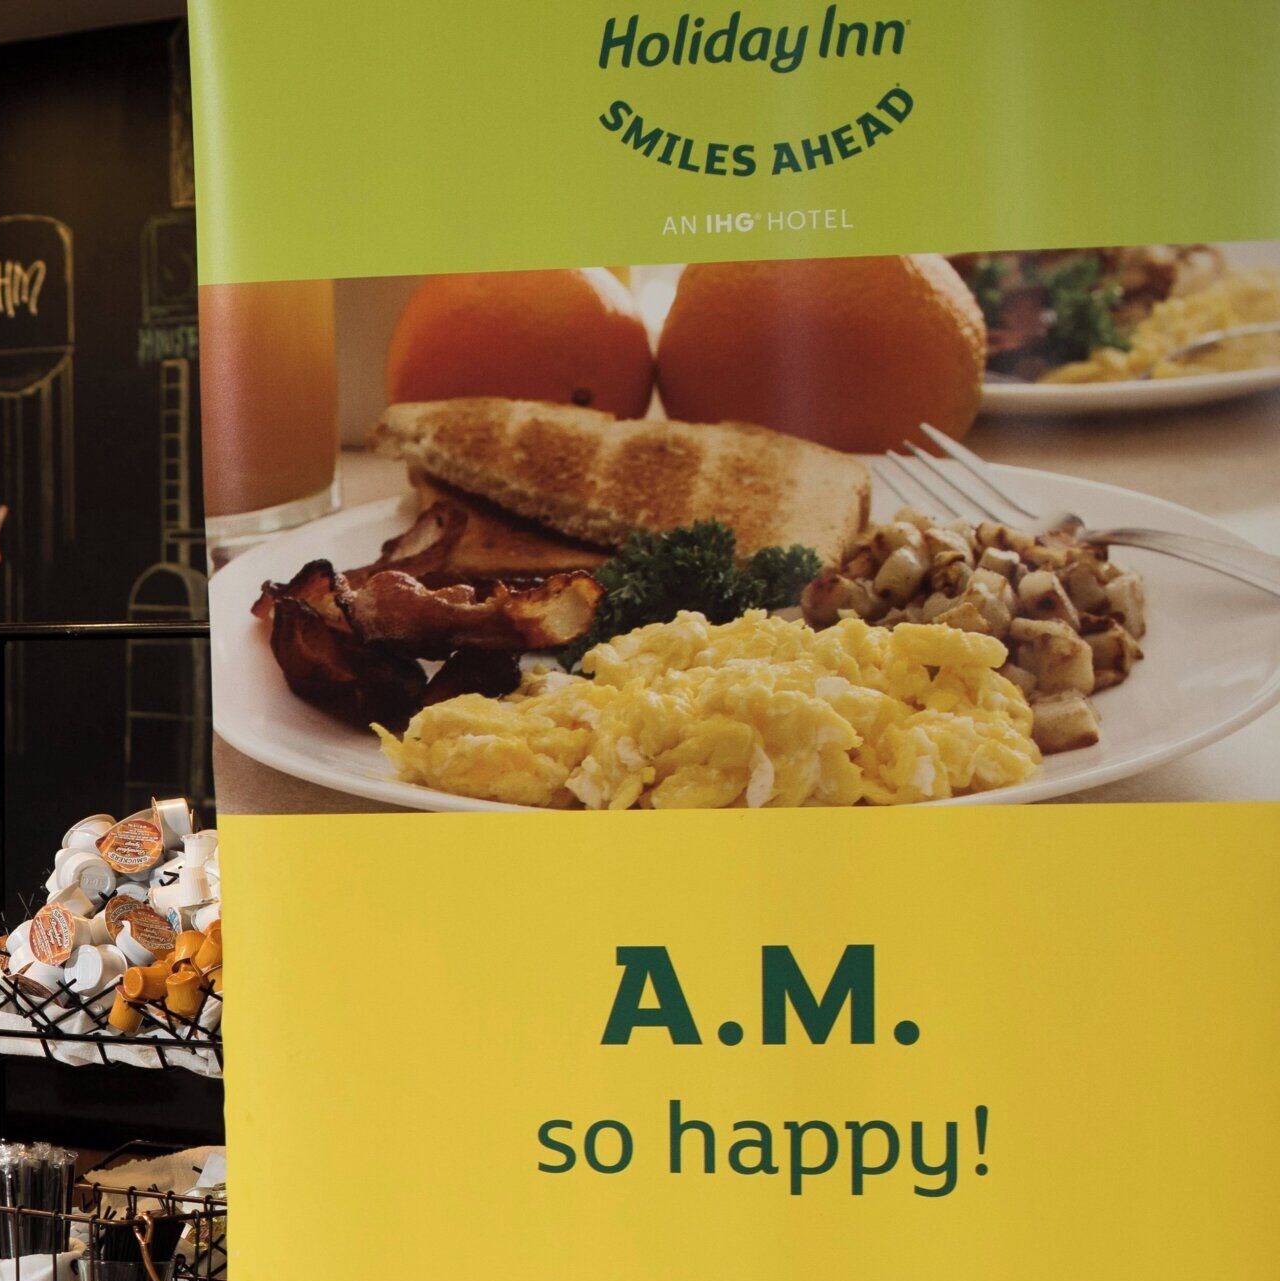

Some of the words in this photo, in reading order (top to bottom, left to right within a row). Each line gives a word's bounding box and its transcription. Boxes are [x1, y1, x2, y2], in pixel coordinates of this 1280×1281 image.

[598, 10, 808, 74] Holiday
[819, 3, 906, 58] Inn
[598, 99, 757, 177] SMILES
[771, 86, 915, 176] AHEAD
[662, 214, 697, 236] AN
[767, 208, 854, 231] HOTEL
[109, 852, 149, 864] SMUCKERS
[600, 944, 921, 1047] A.M.
[536, 1119, 634, 1174] so
[668, 1099, 990, 1198] happy!
